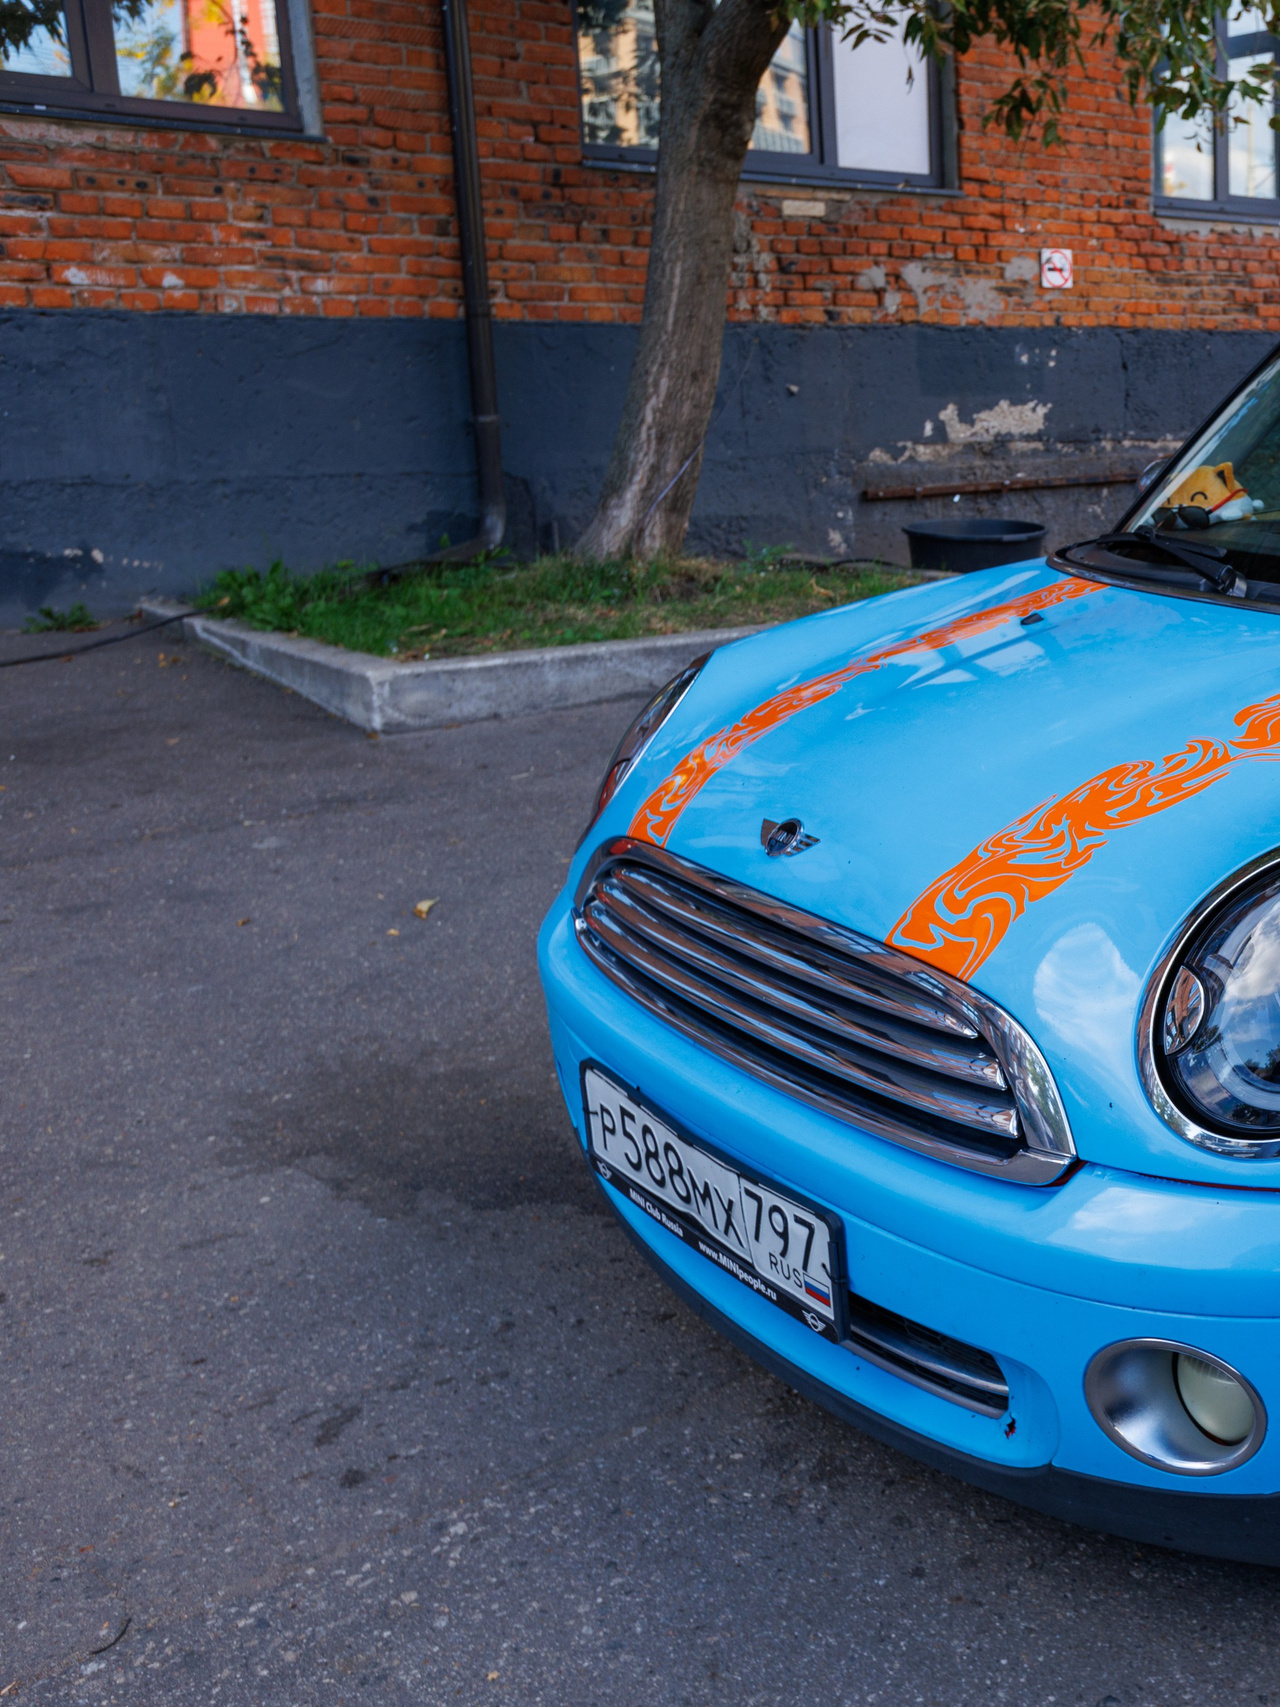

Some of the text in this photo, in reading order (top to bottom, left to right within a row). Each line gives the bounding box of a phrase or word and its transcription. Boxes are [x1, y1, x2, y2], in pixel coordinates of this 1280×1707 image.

[629, 1187, 646, 1209] MINI
[645, 1201, 661, 1221] Club
[661, 1212, 684, 1238] Russia
[744, 1187, 816, 1273] 797
[769, 1252, 803, 1289] RUS
